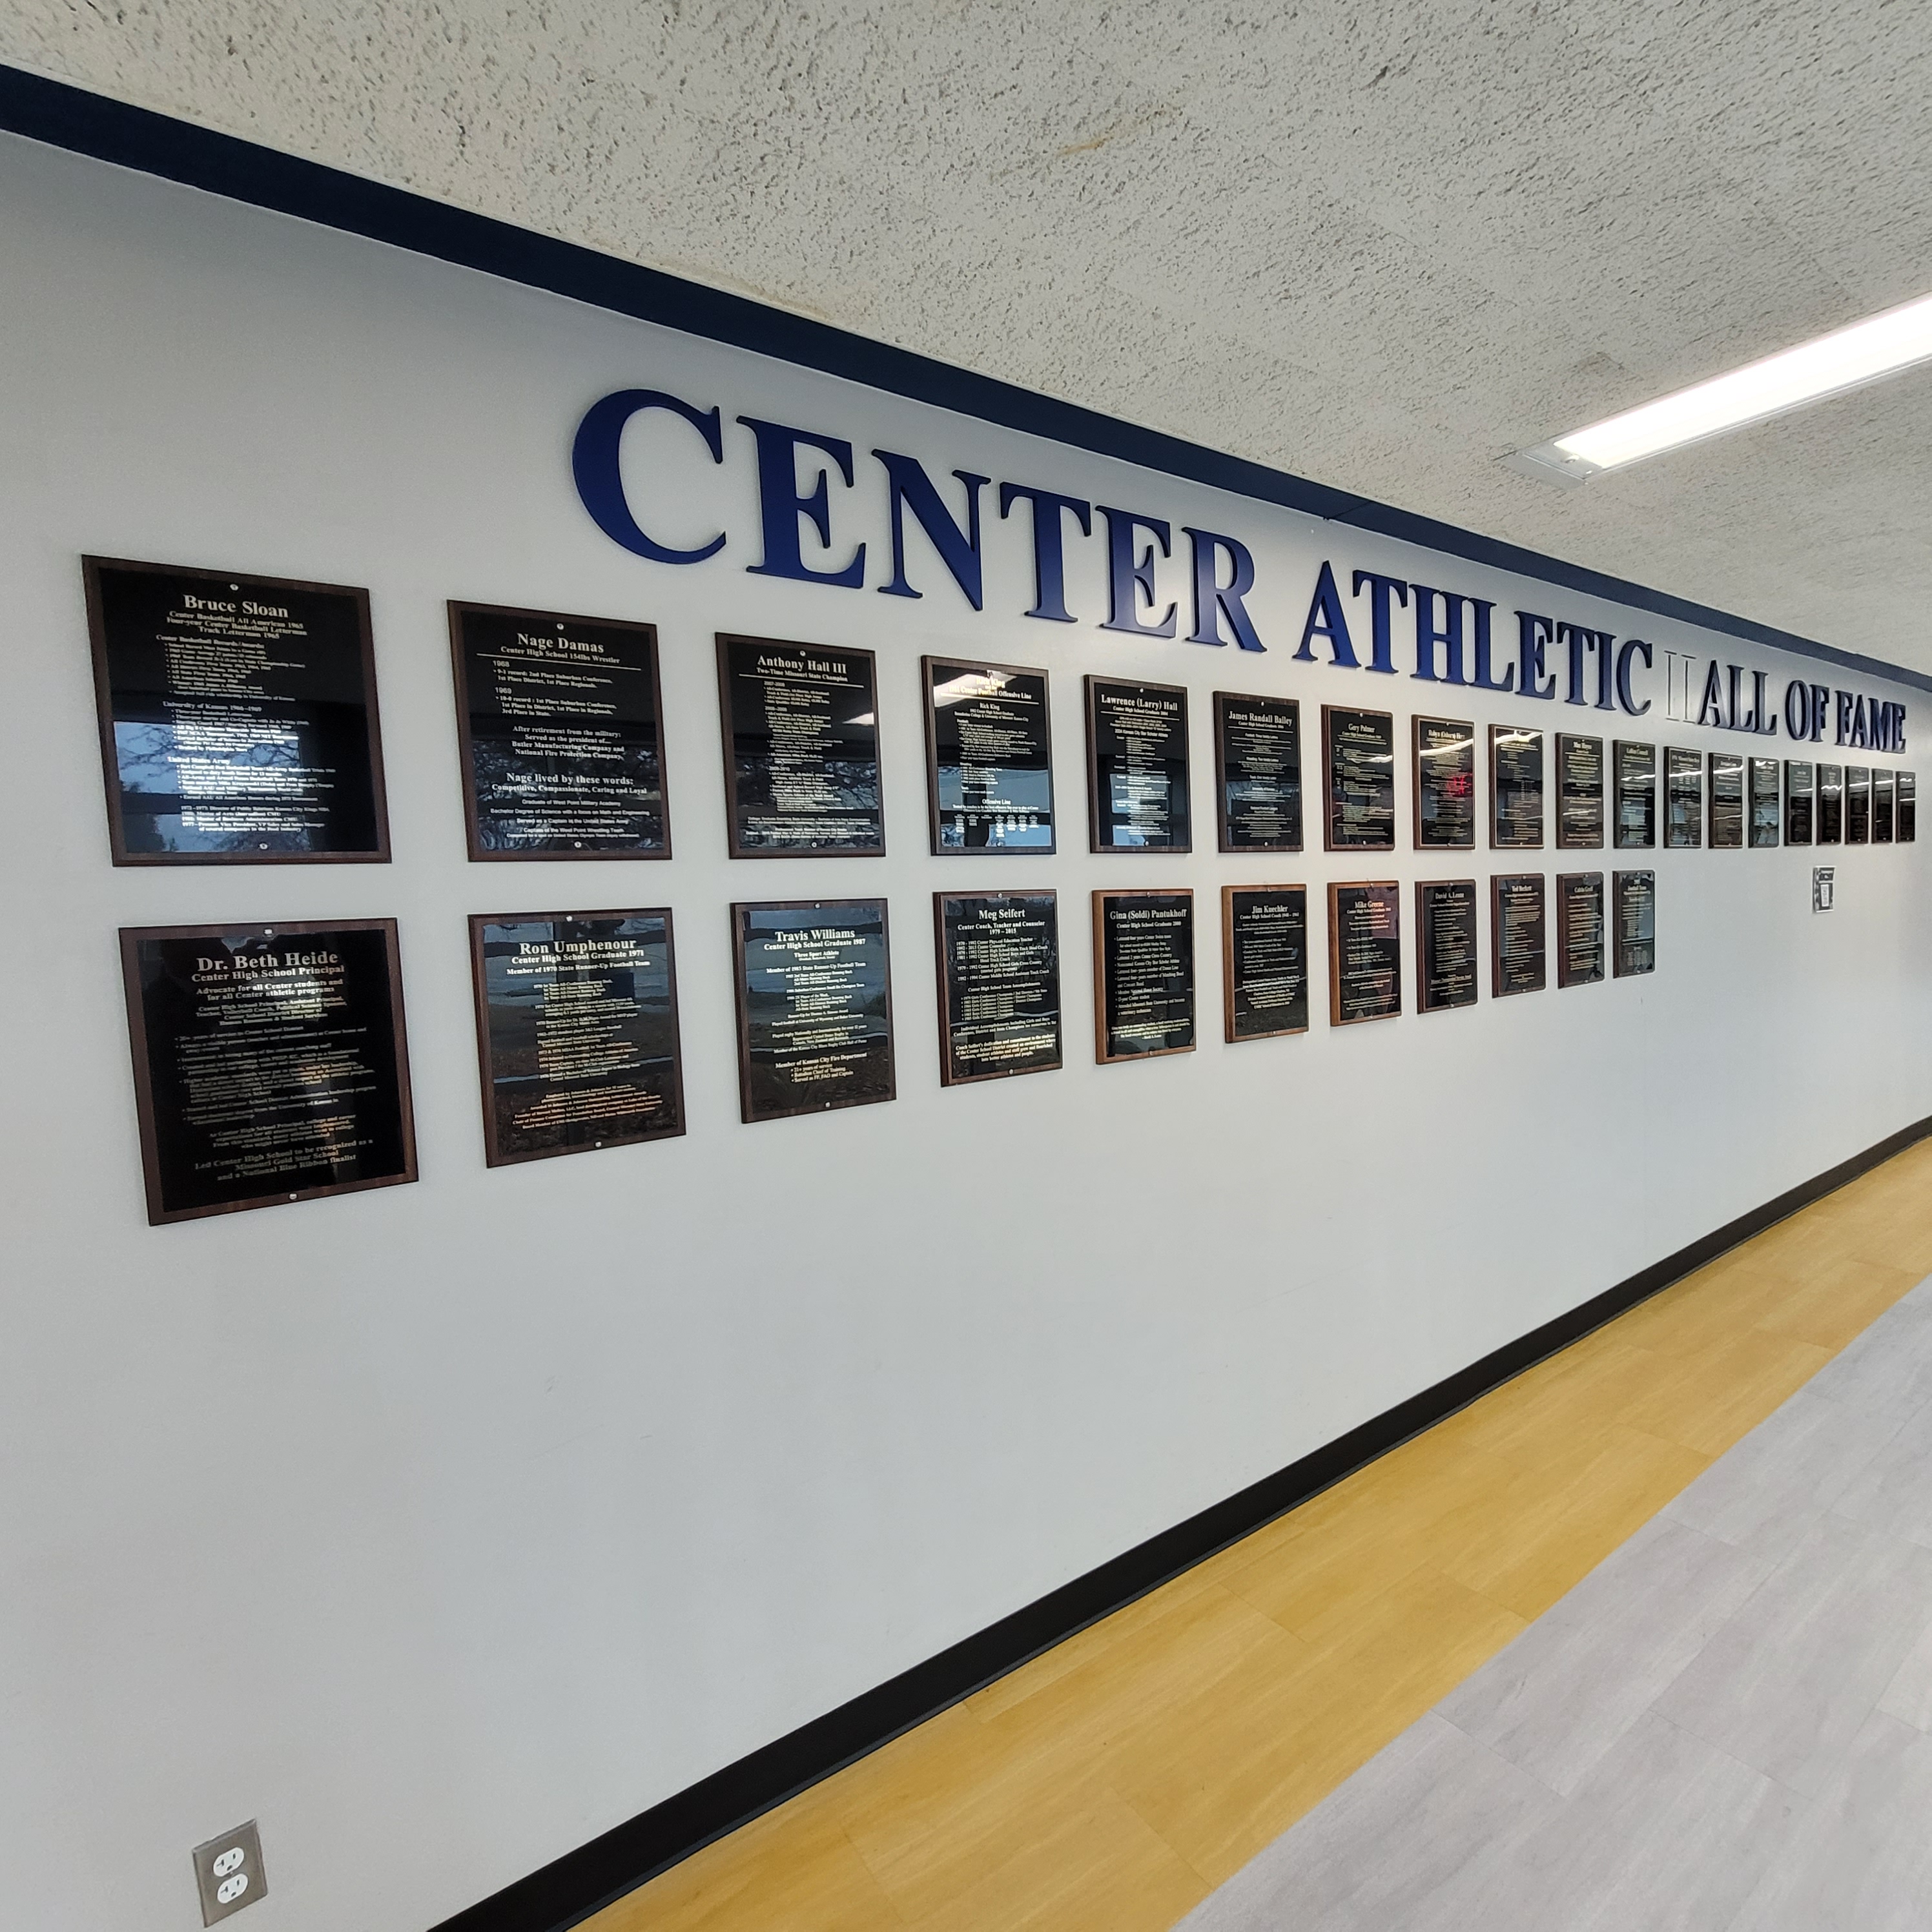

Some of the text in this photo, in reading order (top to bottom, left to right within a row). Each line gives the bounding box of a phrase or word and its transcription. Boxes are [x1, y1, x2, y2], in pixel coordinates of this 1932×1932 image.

[572, 389, 1267, 652] CENTER
[1291, 560, 1652, 716] ATHLETIC
[1785, 680, 1830, 743] OF
[1834, 690, 1906, 754] FAME
[185, 595, 288, 617] Bruce Sloan
[197, 613, 234, 622] Basketball
[167, 617, 307, 635] Four-year Center Basketball Letterman
[223, 628, 261, 637] Letterman
[518, 633, 604, 653] Nage Damas
[758, 656, 846, 673] Anthony Hall III
[1102, 694, 1177, 710] Lawrence (Larry) Hall
[1229, 711, 1292, 726] James Randall Bailey
[535, 742, 582, 750] Manufacturing
[507, 773, 532, 784] Nage
[535, 774, 559, 783] lived
[561, 775, 575, 785] by
[979, 909, 1025, 921] Meg Seifert
[1110, 909, 1187, 920] Gina (Soldi) Pantukhoff
[775, 929, 855, 941] Travis Williams
[520, 940, 636, 955] Ron Umphenour
[197, 951, 337, 971] Dr. Beth Heide
[232, 971, 258, 980] High
[262, 969, 296, 977] School
[298, 966, 344, 975] Principal
